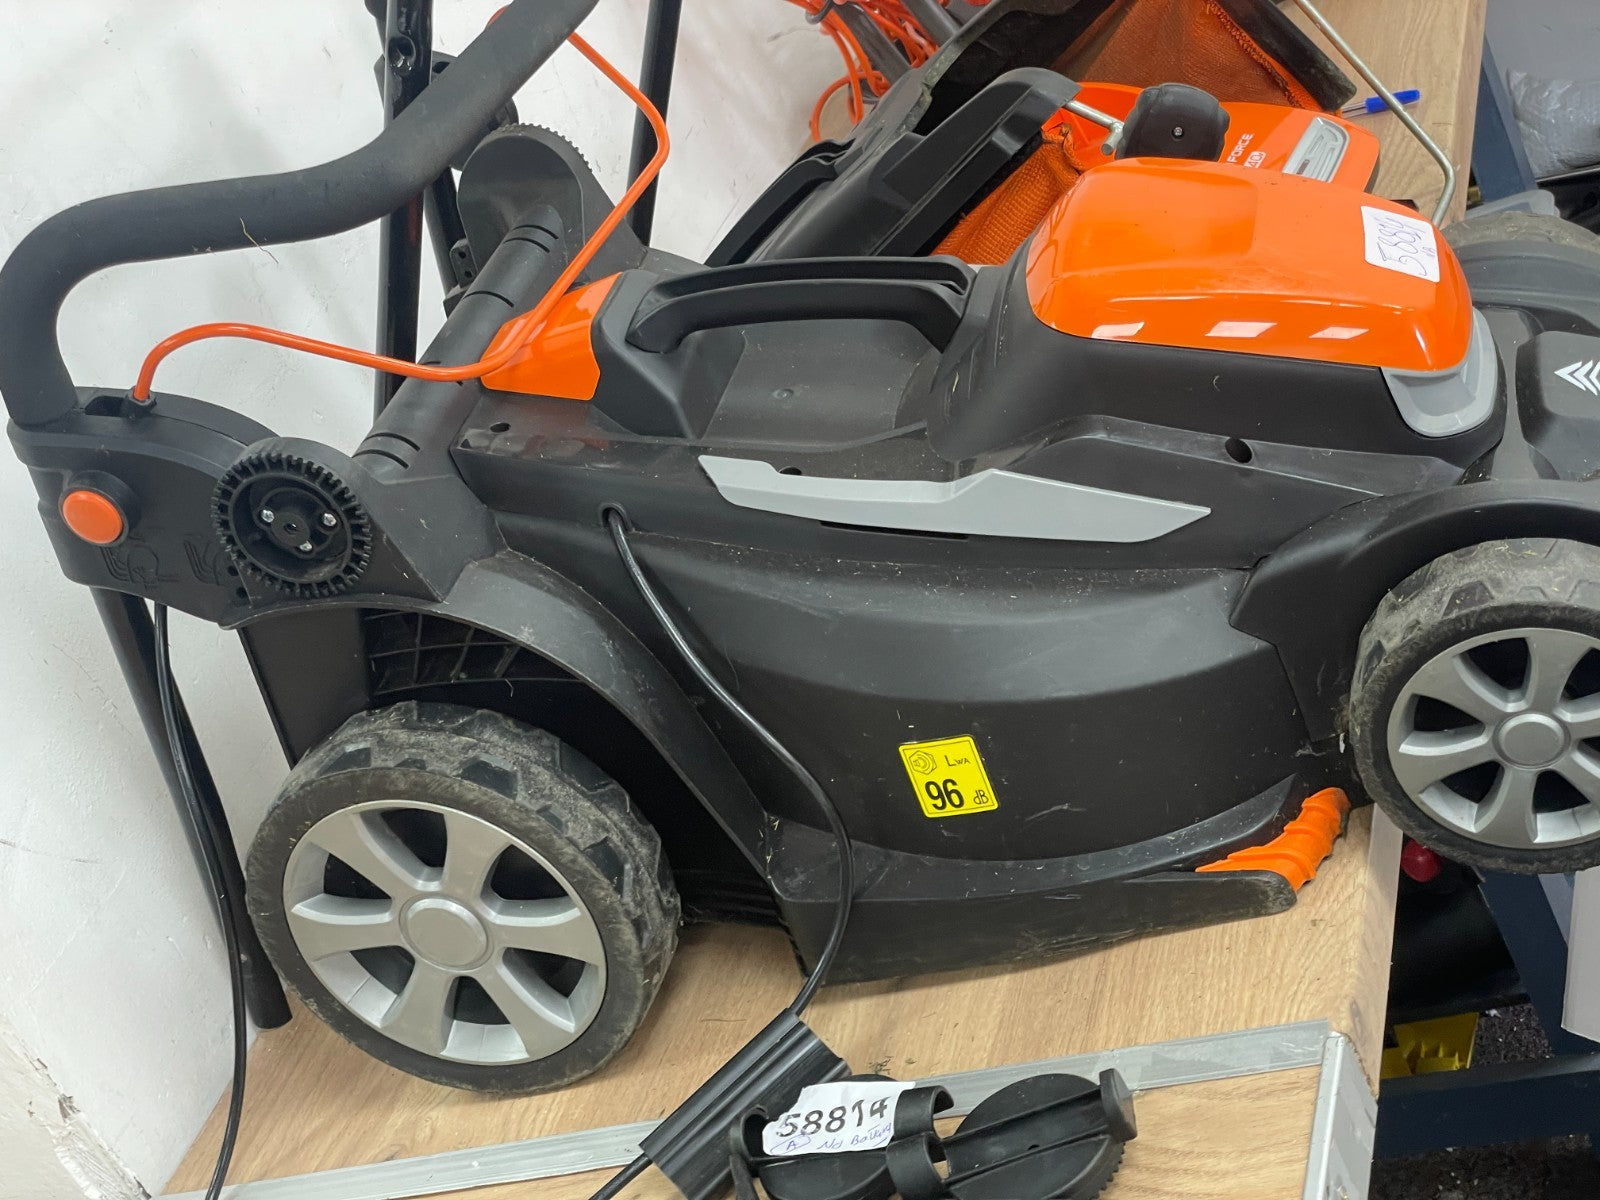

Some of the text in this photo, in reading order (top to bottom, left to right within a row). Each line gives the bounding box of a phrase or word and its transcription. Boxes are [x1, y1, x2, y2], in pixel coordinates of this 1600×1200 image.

[1226, 133, 1254, 163] FORCE
[924, 778, 989, 811] 96 dB
